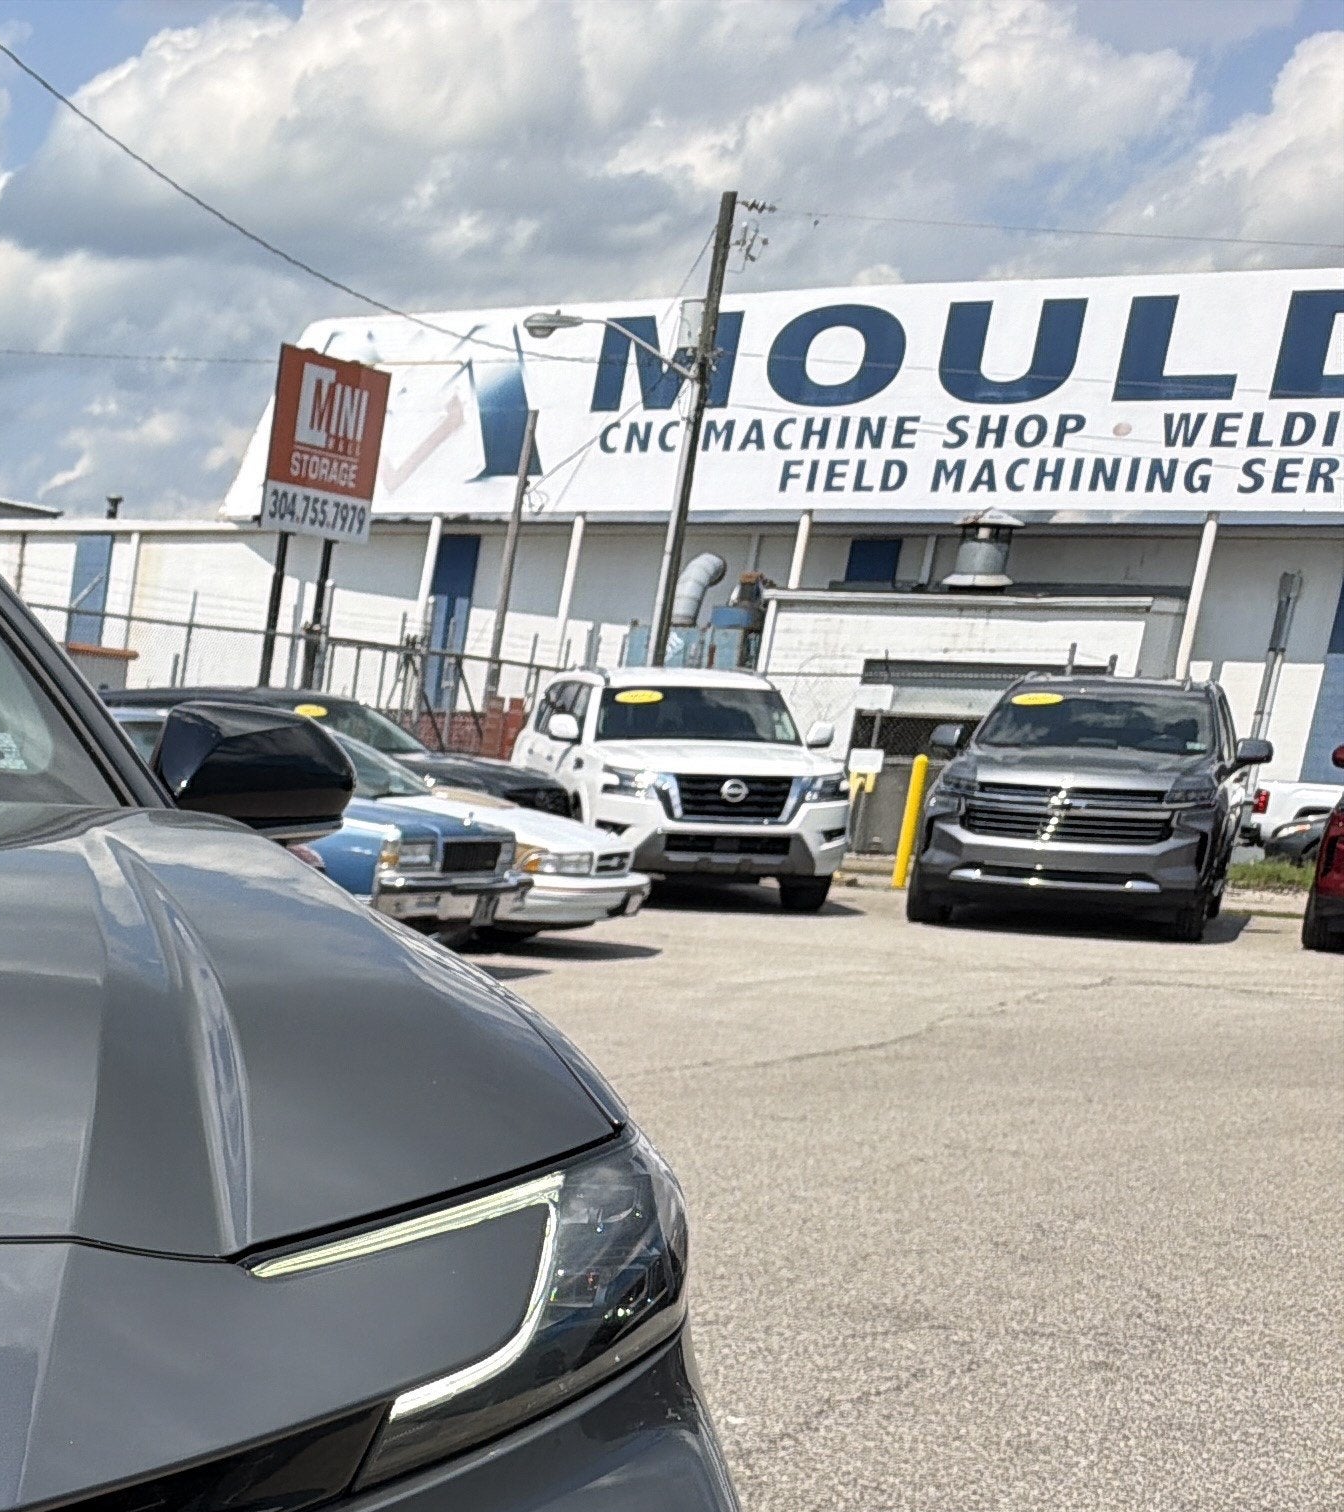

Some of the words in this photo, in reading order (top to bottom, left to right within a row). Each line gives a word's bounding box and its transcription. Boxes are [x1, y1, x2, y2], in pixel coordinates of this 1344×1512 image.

[599, 421, 681, 453] CNC
[702, 415, 921, 451] MACHINE
[942, 413, 1087, 449] SHOP
[290, 450, 359, 488] STORAGE
[778, 458, 909, 493] FIELD
[930, 457, 1212, 493] MACHINING
[269, 488, 367, 536] 304.755.7979
